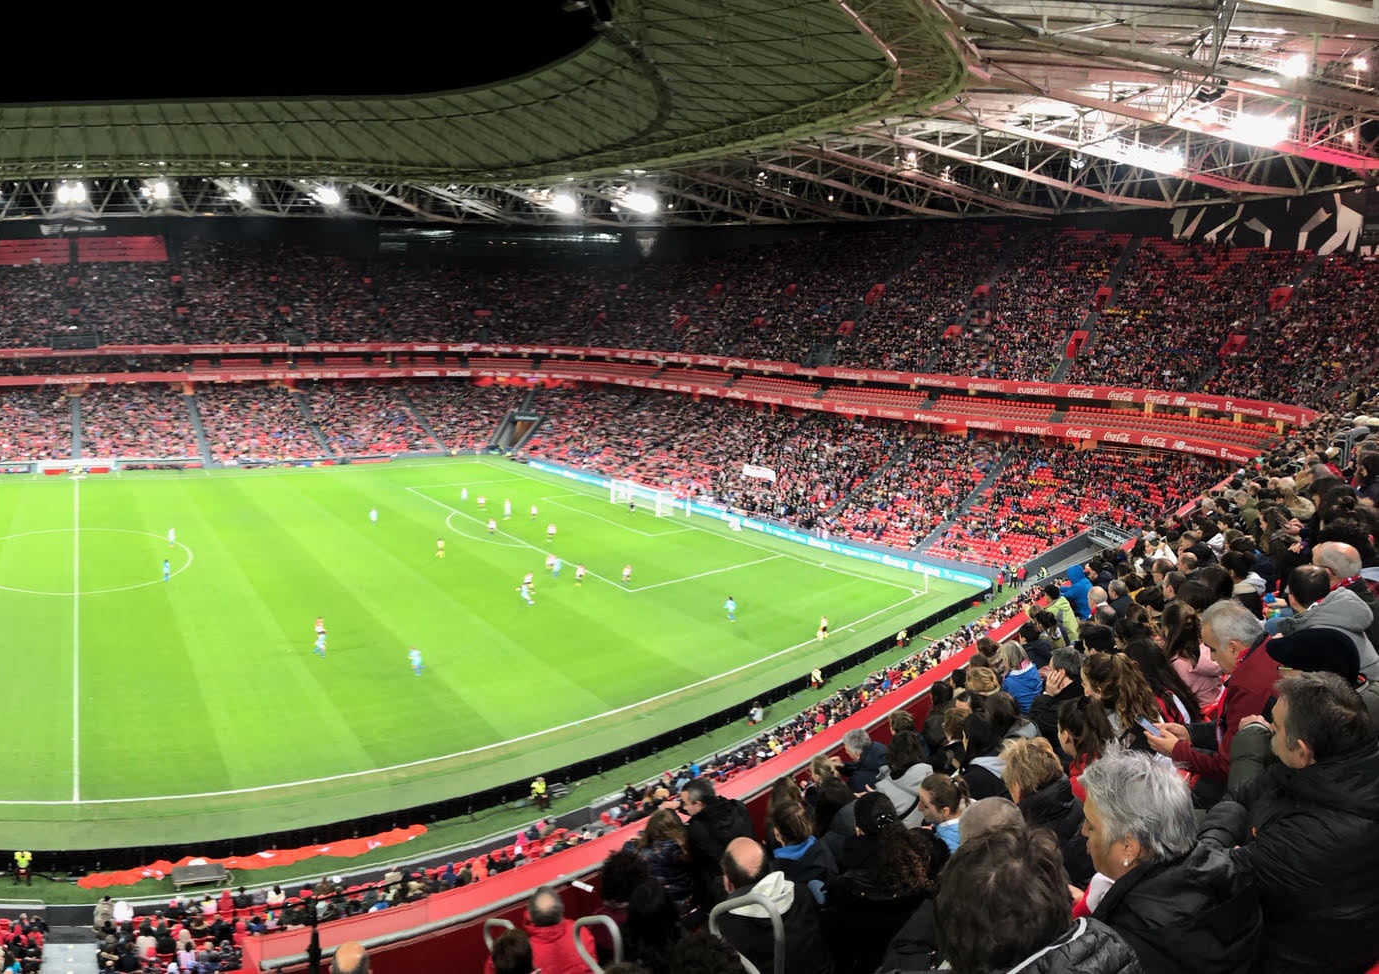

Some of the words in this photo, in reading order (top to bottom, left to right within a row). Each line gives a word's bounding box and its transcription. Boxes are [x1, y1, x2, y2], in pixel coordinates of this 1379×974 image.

[1018, 386, 1049, 395] euskaltel
[1197, 401, 1219, 410] balance
[1015, 425, 1047, 435] euskaltel
[1195, 446, 1217, 456] balance
